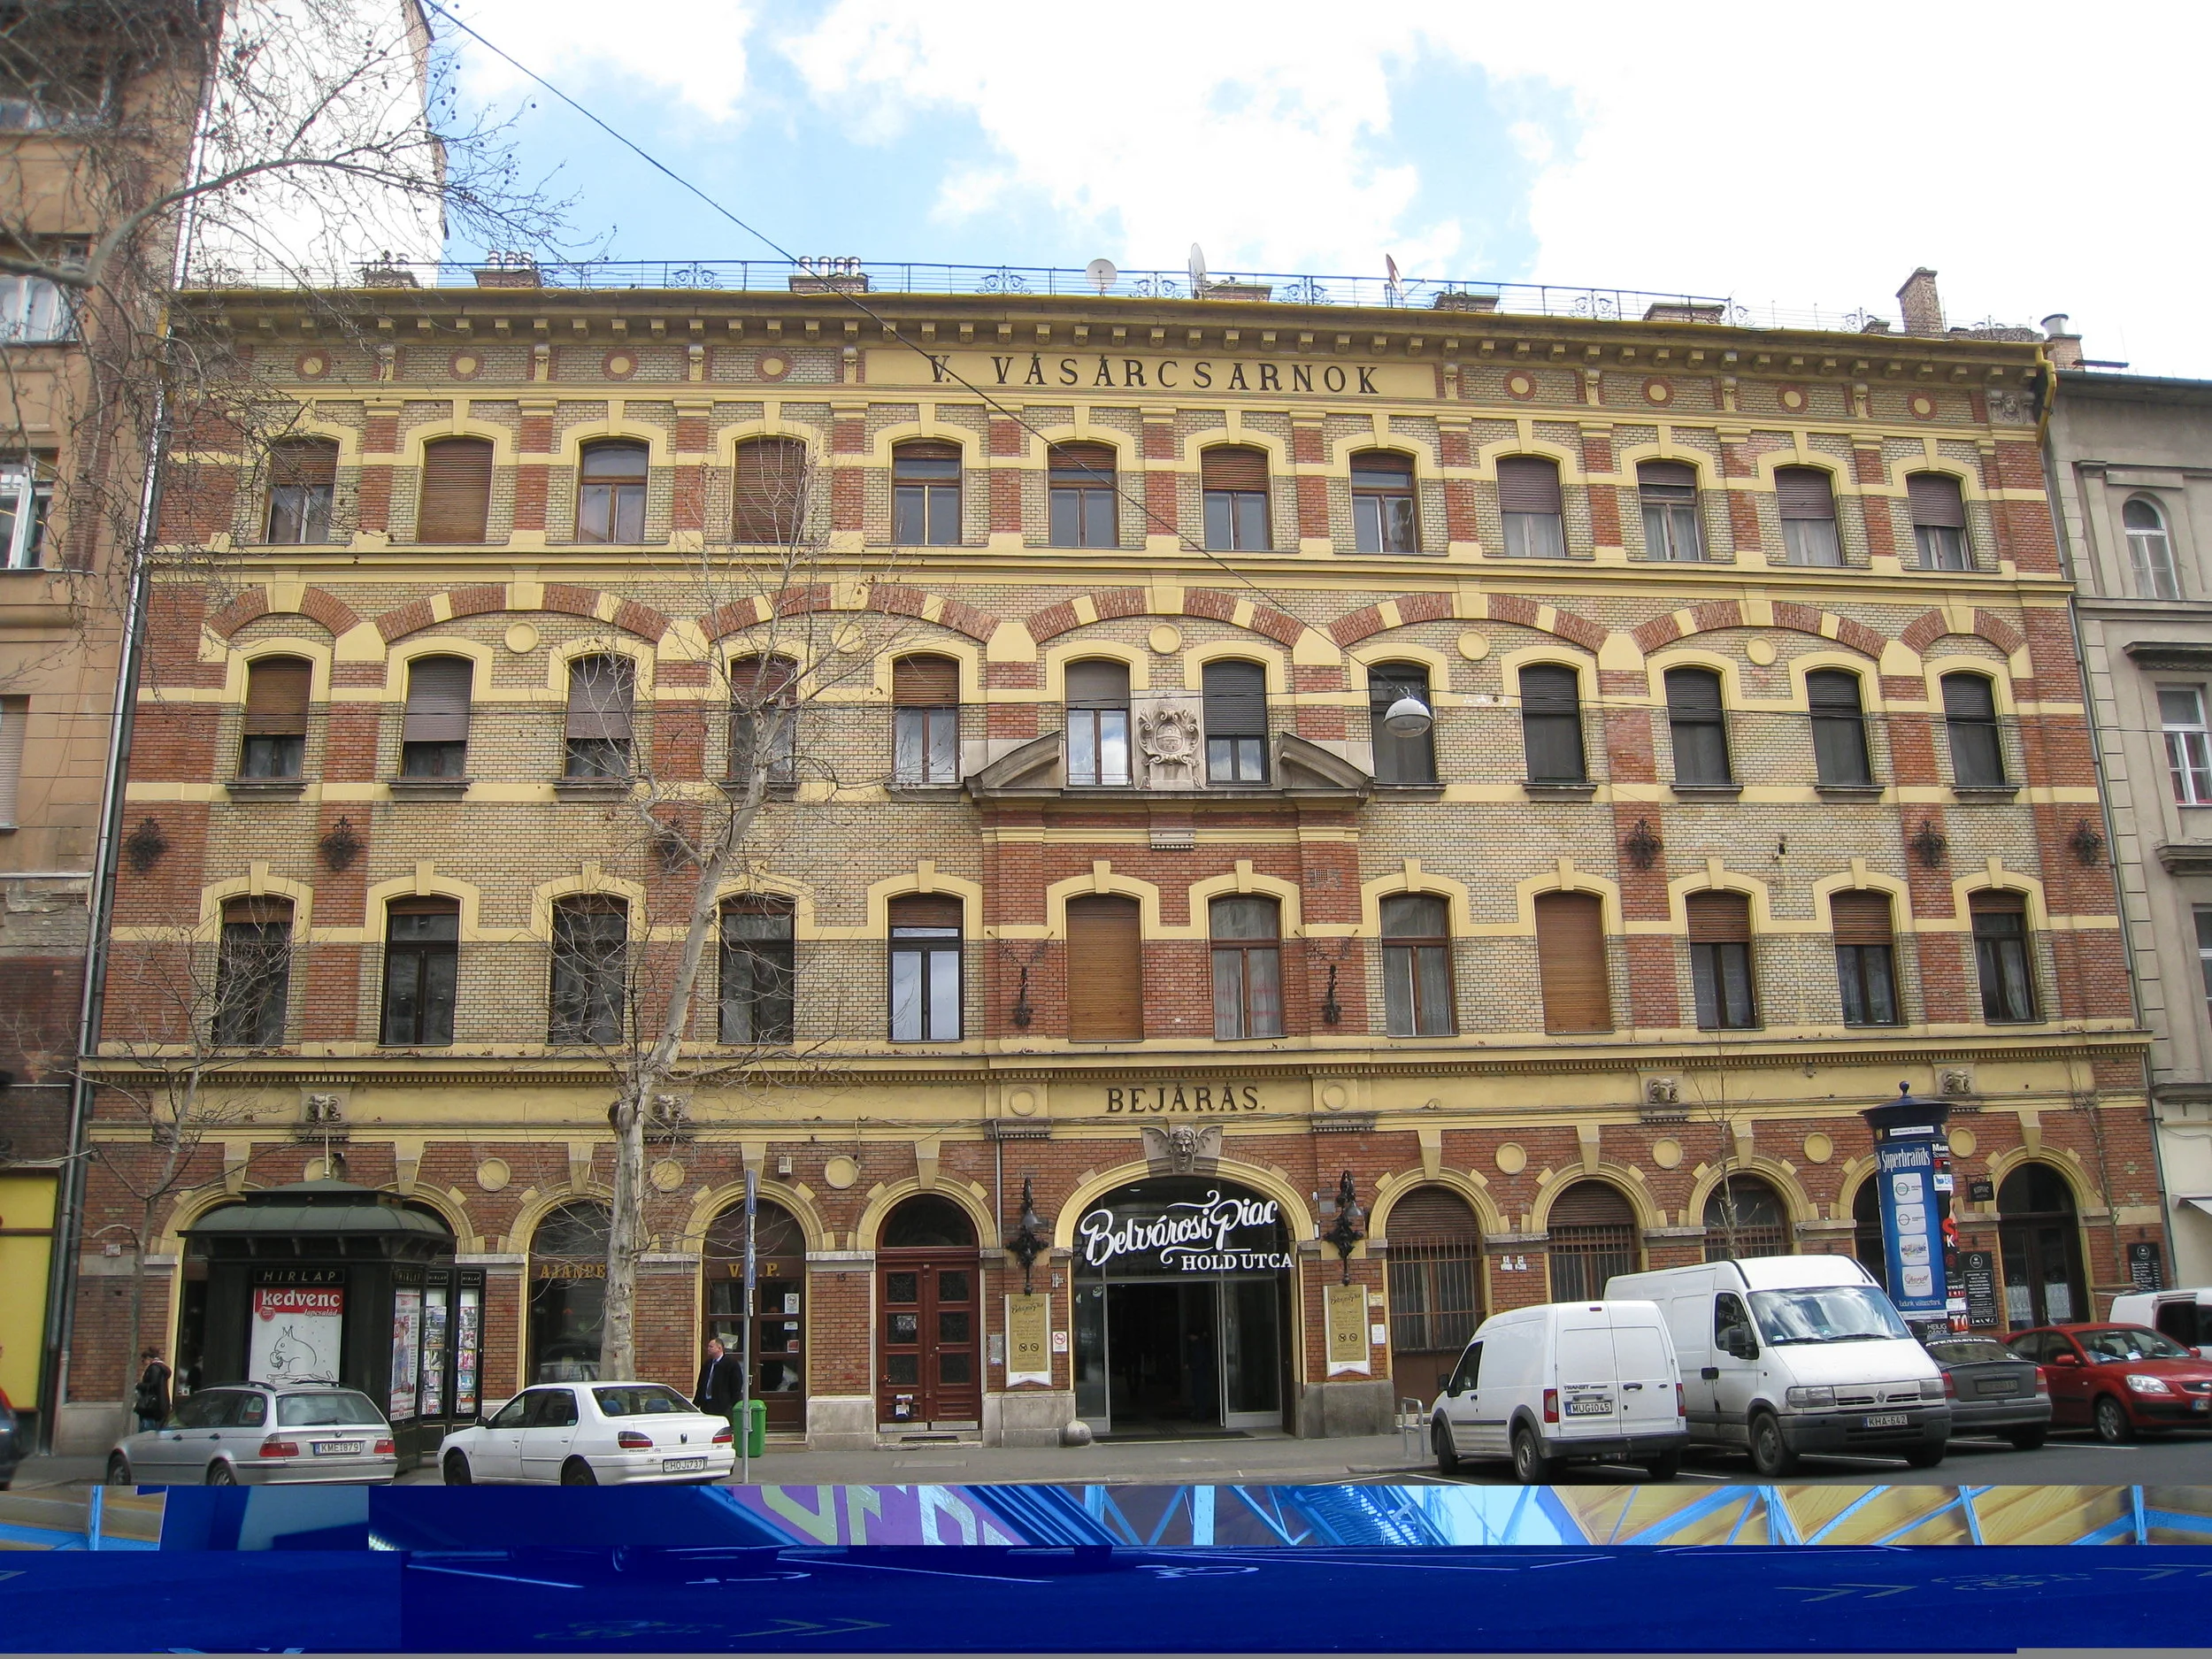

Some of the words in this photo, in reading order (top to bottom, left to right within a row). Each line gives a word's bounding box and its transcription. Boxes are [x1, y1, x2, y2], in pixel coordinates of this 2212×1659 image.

[990, 351, 1379, 395] VÁSÁRCSARNOK
[1881, 1148, 1931, 1173] Superbrands
[1079, 1208, 1212, 1266] Belvárosi
[1210, 1197, 1279, 1251] Piac
[1181, 1254, 1237, 1271] HOLD
[1238, 1252, 1295, 1270] UTCA
[262, 1288, 341, 1307] kedvenc
